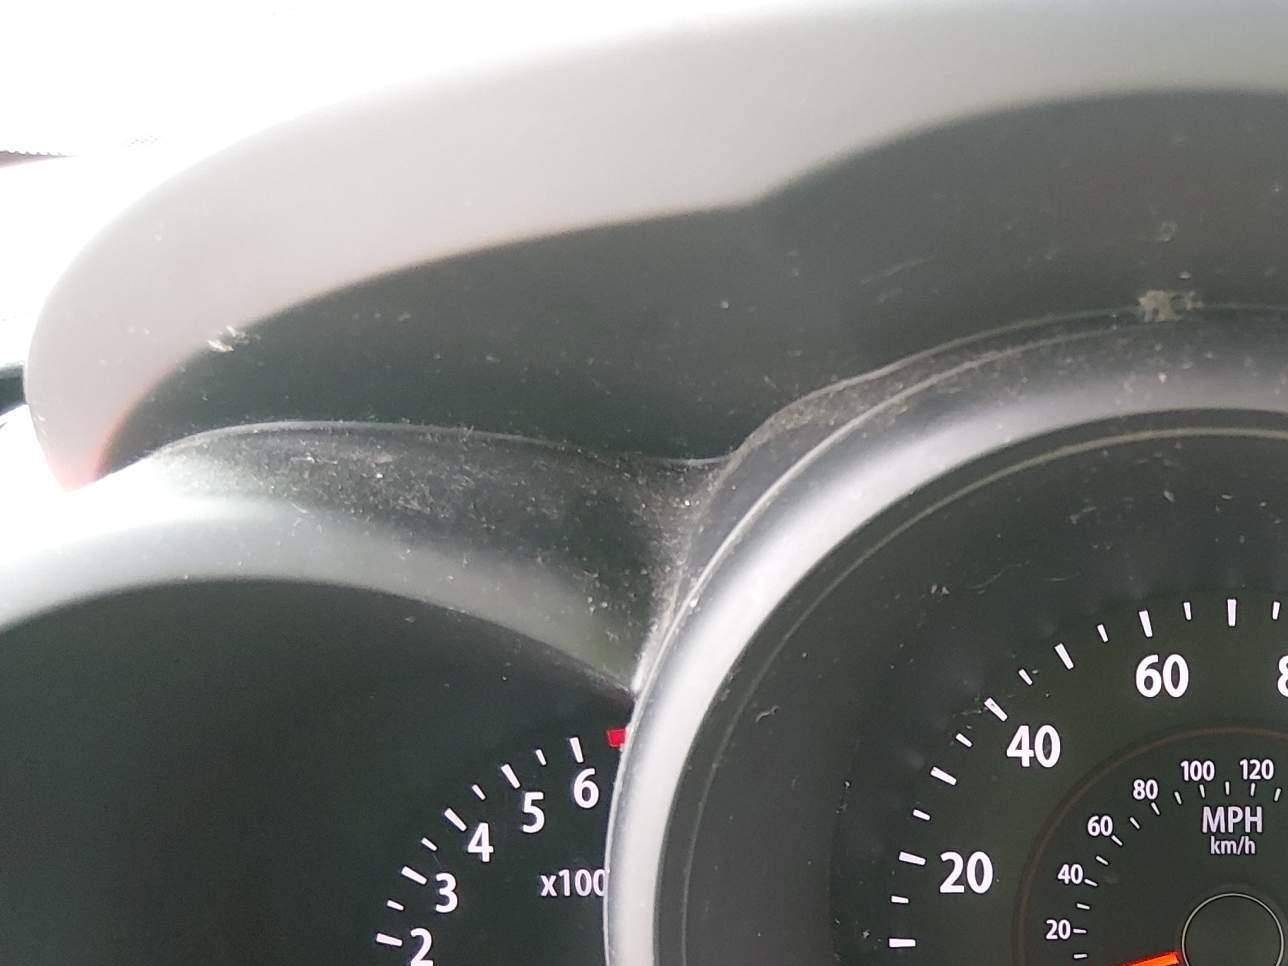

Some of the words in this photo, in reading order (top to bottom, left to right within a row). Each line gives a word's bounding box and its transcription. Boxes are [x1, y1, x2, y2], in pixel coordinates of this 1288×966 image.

[1135, 653, 1189, 698] 60
[1006, 725, 1061, 768] 40
[1180, 760, 1216, 782] 100
[1239, 758, 1275, 780] 120
[572, 767, 600, 809] 6
[1132, 779, 1159, 801] 80
[521, 791, 546, 834] 5
[1087, 815, 1115, 838] 60
[1201, 805, 1264, 834] MPH
[466, 822, 495, 863] 4
[1209, 834, 1257, 856] km/h
[938, 850, 1000, 895] 20
[1057, 863, 1085, 885] 40
[434, 872, 459, 914] 3
[1045, 919, 1071, 941] 20
